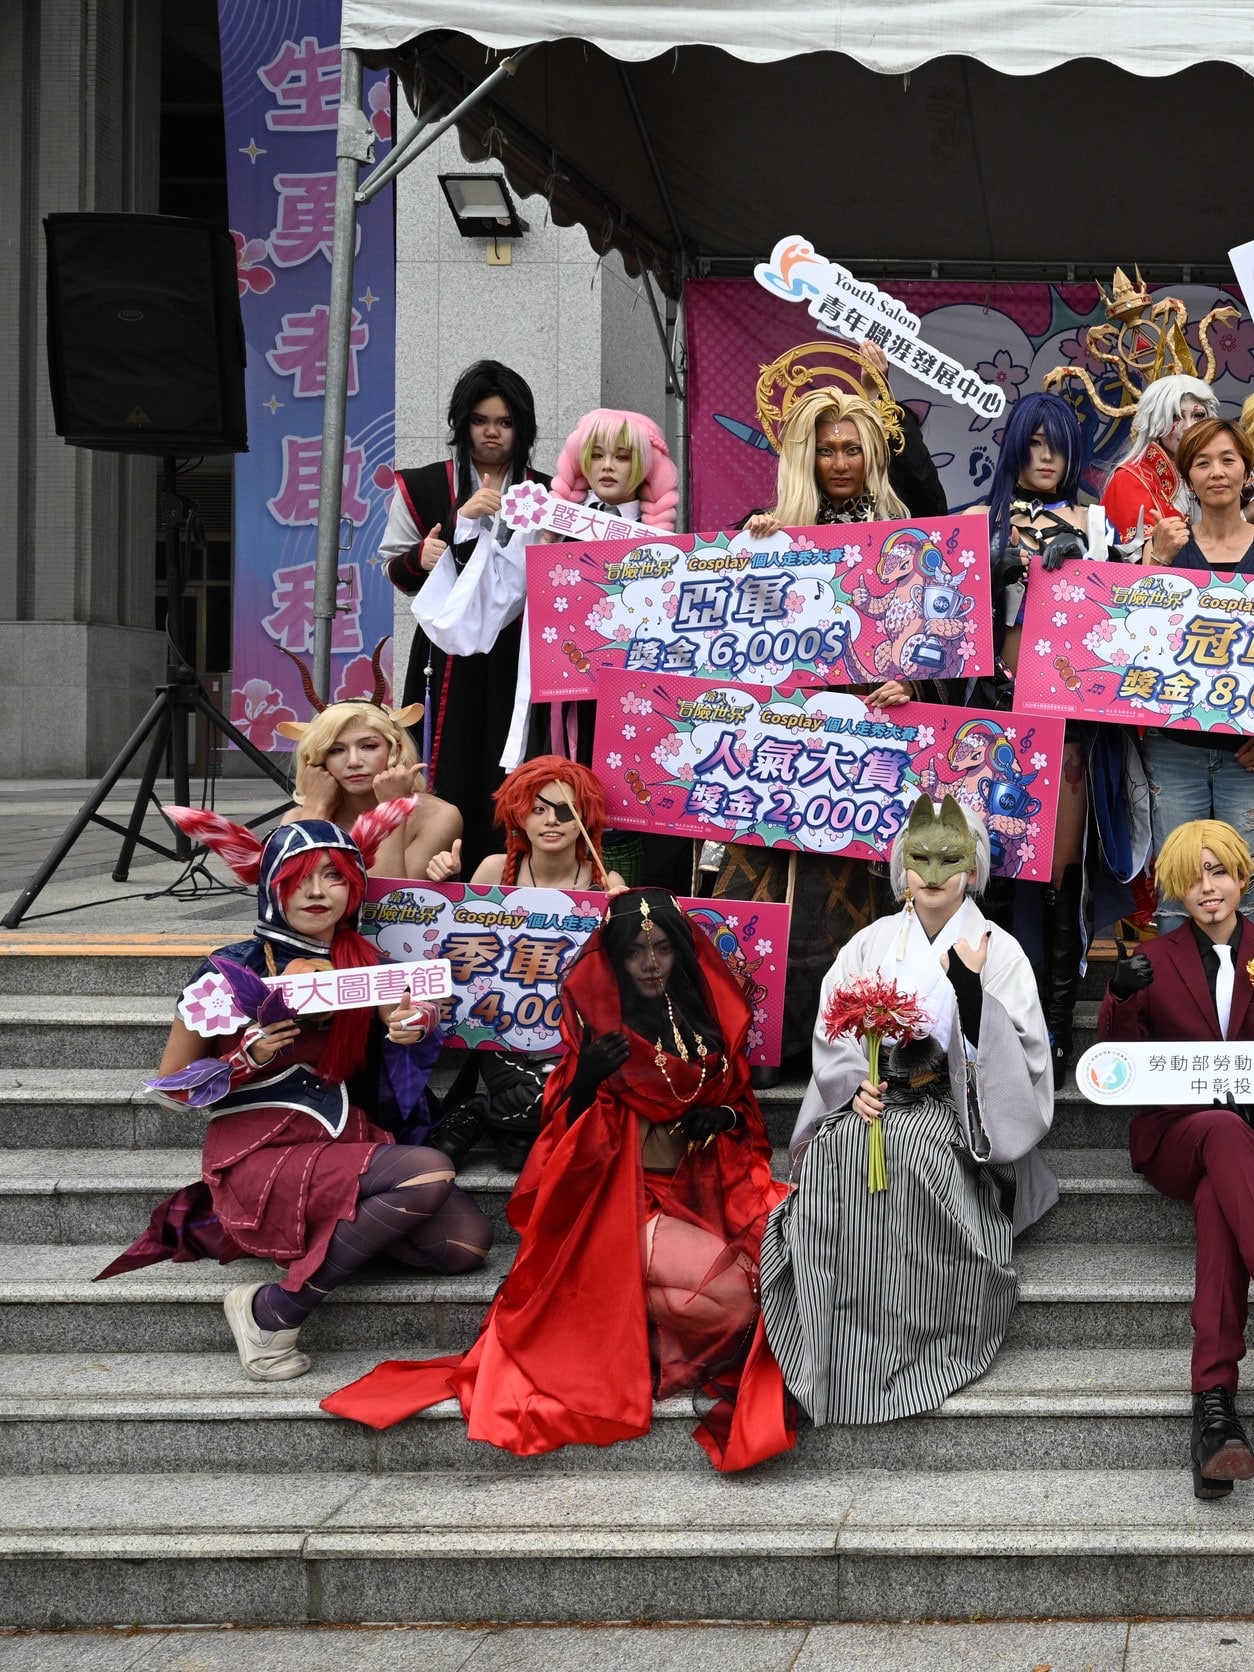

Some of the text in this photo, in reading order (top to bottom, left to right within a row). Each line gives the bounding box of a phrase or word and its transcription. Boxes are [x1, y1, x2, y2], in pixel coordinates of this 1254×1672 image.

[835, 272, 917, 332] Youth Salon
[818, 294, 1002, 413] 青年職涯發展中心
[606, 557, 677, 580] 冒險世界
[630, 549, 653, 562] 踏入
[688, 549, 844, 571] Cosplay 個人走秀大賽
[1112, 586, 1190, 609] 冒險世界
[1140, 577, 1165, 590] 踏入
[673, 572, 795, 632] 亞軍
[626, 622, 847, 674] 獎金 6,000$
[703, 691, 728, 704] 踏入
[1117, 665, 1199, 703] 獎金
[678, 700, 753, 724] 冒險世界
[761, 710, 918, 742] Cosplay 個人走秀大賽
[694, 731, 911, 796] 人氣大賞
[686, 783, 907, 841] 獎金 2,000$
[388, 891, 416, 904] 踏入
[361, 903, 445, 925] 冒險世界
[455, 909, 602, 932] Cosplay 個人走秀
[438, 932, 575, 987] 季軍
[468, 991, 563, 1033] 4,00
